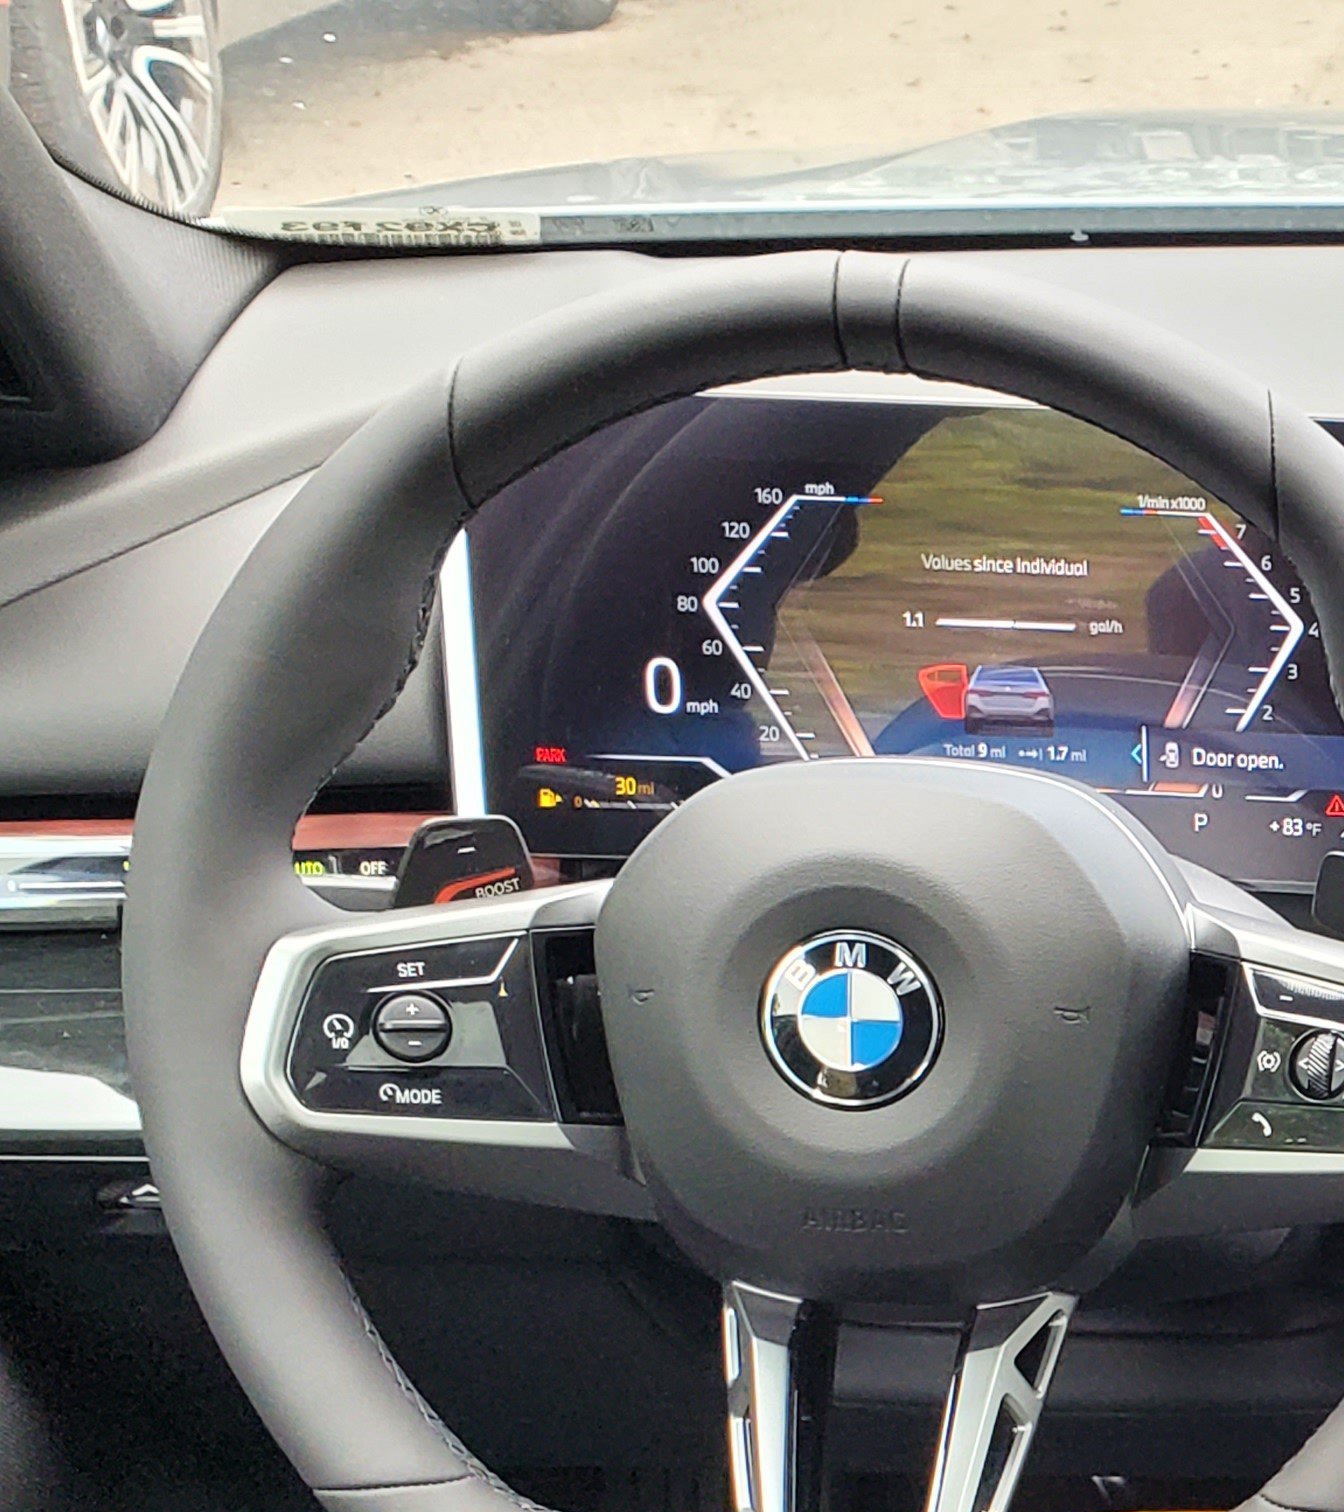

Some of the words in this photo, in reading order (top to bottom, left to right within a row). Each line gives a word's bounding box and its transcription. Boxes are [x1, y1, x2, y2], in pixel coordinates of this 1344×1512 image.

[754, 488, 783, 505] 160
[805, 482, 835, 496] mph
[1170, 497, 1206, 511] x1000
[721, 522, 750, 539] 120
[1235, 524, 1247, 540] 7
[690, 557, 719, 574] 100
[921, 553, 972, 571] Values
[973, 555, 1014, 574] since
[1016, 556, 1088, 576] Individual
[1260, 555, 1273, 571] 6
[677, 595, 698, 612] 80
[1290, 587, 1301, 603] 5
[902, 611, 925, 628] 1.1
[1089, 619, 1124, 636] gal/h
[1308, 621, 1320, 638] 4
[702, 639, 723, 656] 60
[1287, 664, 1298, 680] 3
[645, 656, 683, 715] 0
[731, 683, 752, 700] 40
[686, 699, 719, 714] mph
[1262, 705, 1274, 721] 2
[759, 725, 780, 742] 20
[535, 747, 567, 763] PARK
[943, 743, 975, 758] Total
[977, 741, 988, 758] 9
[1047, 745, 1069, 762] 1.7
[1191, 747, 1235, 767] Door
[1236, 754, 1284, 772] open.
[615, 777, 637, 796] 30
[574, 797, 582, 808] 0
[1193, 812, 1209, 832] P
[1305, 822, 1322, 837] °F
[360, 861, 386, 877] OFF
[474, 877, 522, 900] BOOST
[396, 961, 426, 978] SET
[783, 941, 923, 996] BMW
[395, 1088, 442, 1106] MODE
